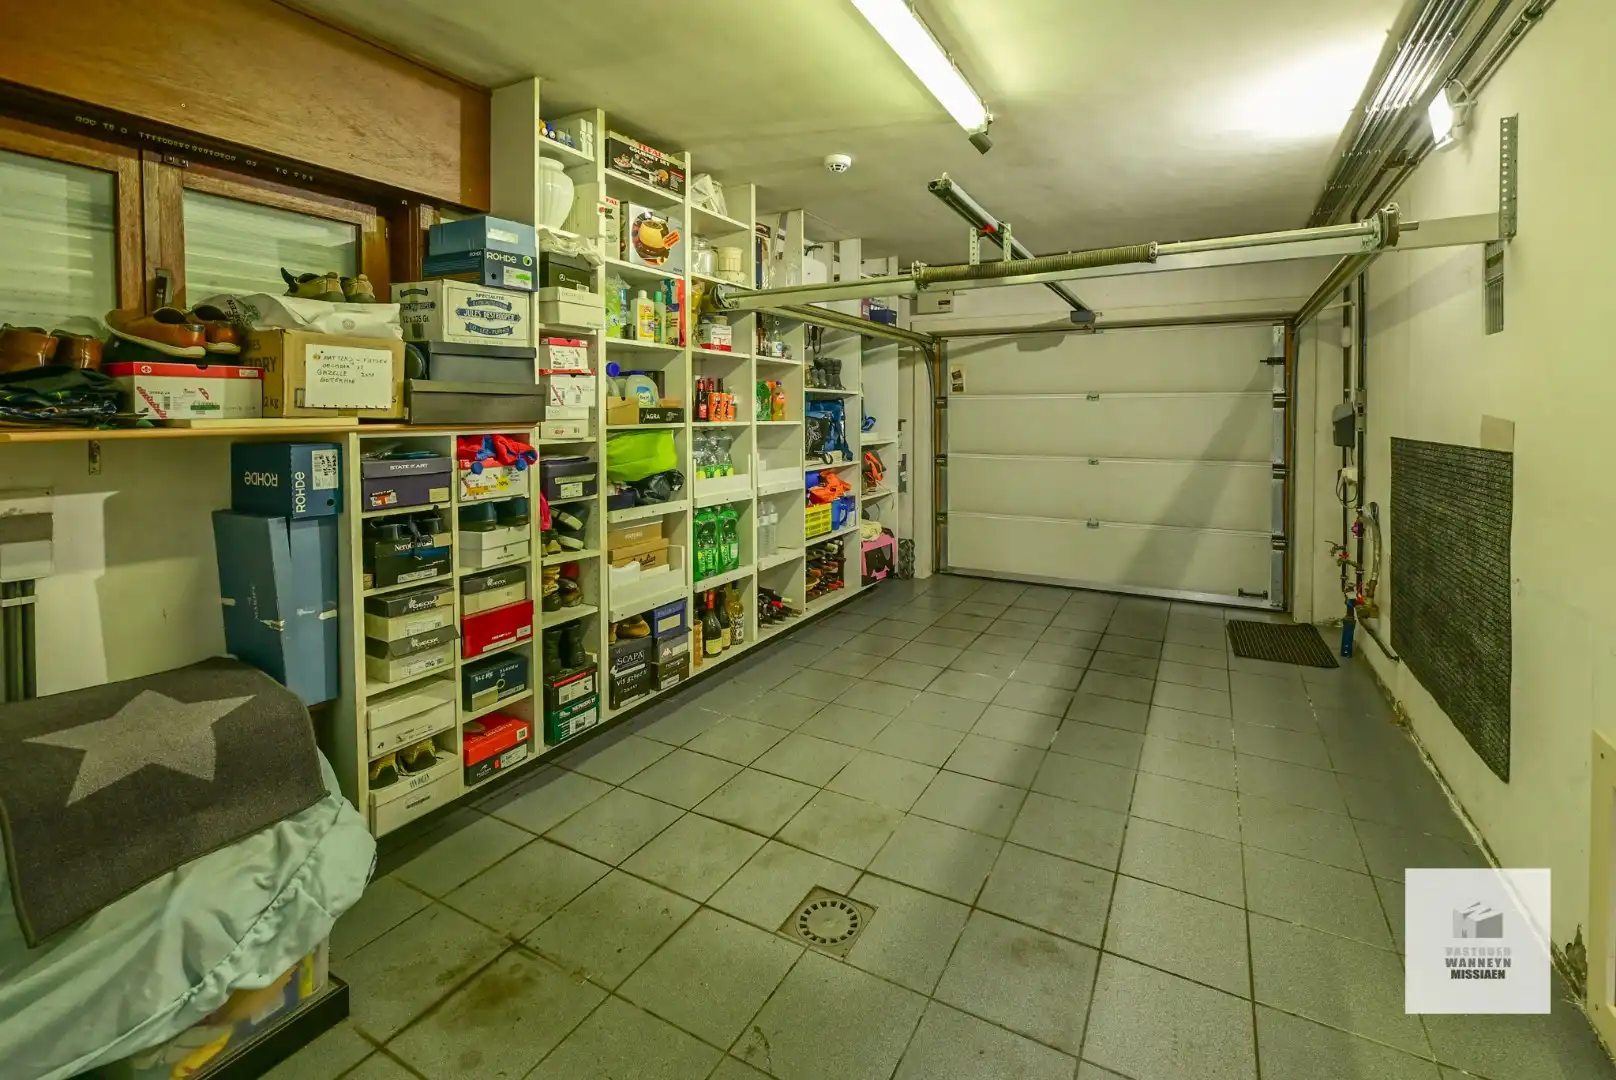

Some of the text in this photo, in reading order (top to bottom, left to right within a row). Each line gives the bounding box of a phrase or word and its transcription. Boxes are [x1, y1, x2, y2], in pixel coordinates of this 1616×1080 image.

[463, 310, 482, 318] JULES
[389, 463, 410, 471] STATE
[616, 650, 645, 667] SCAPA
